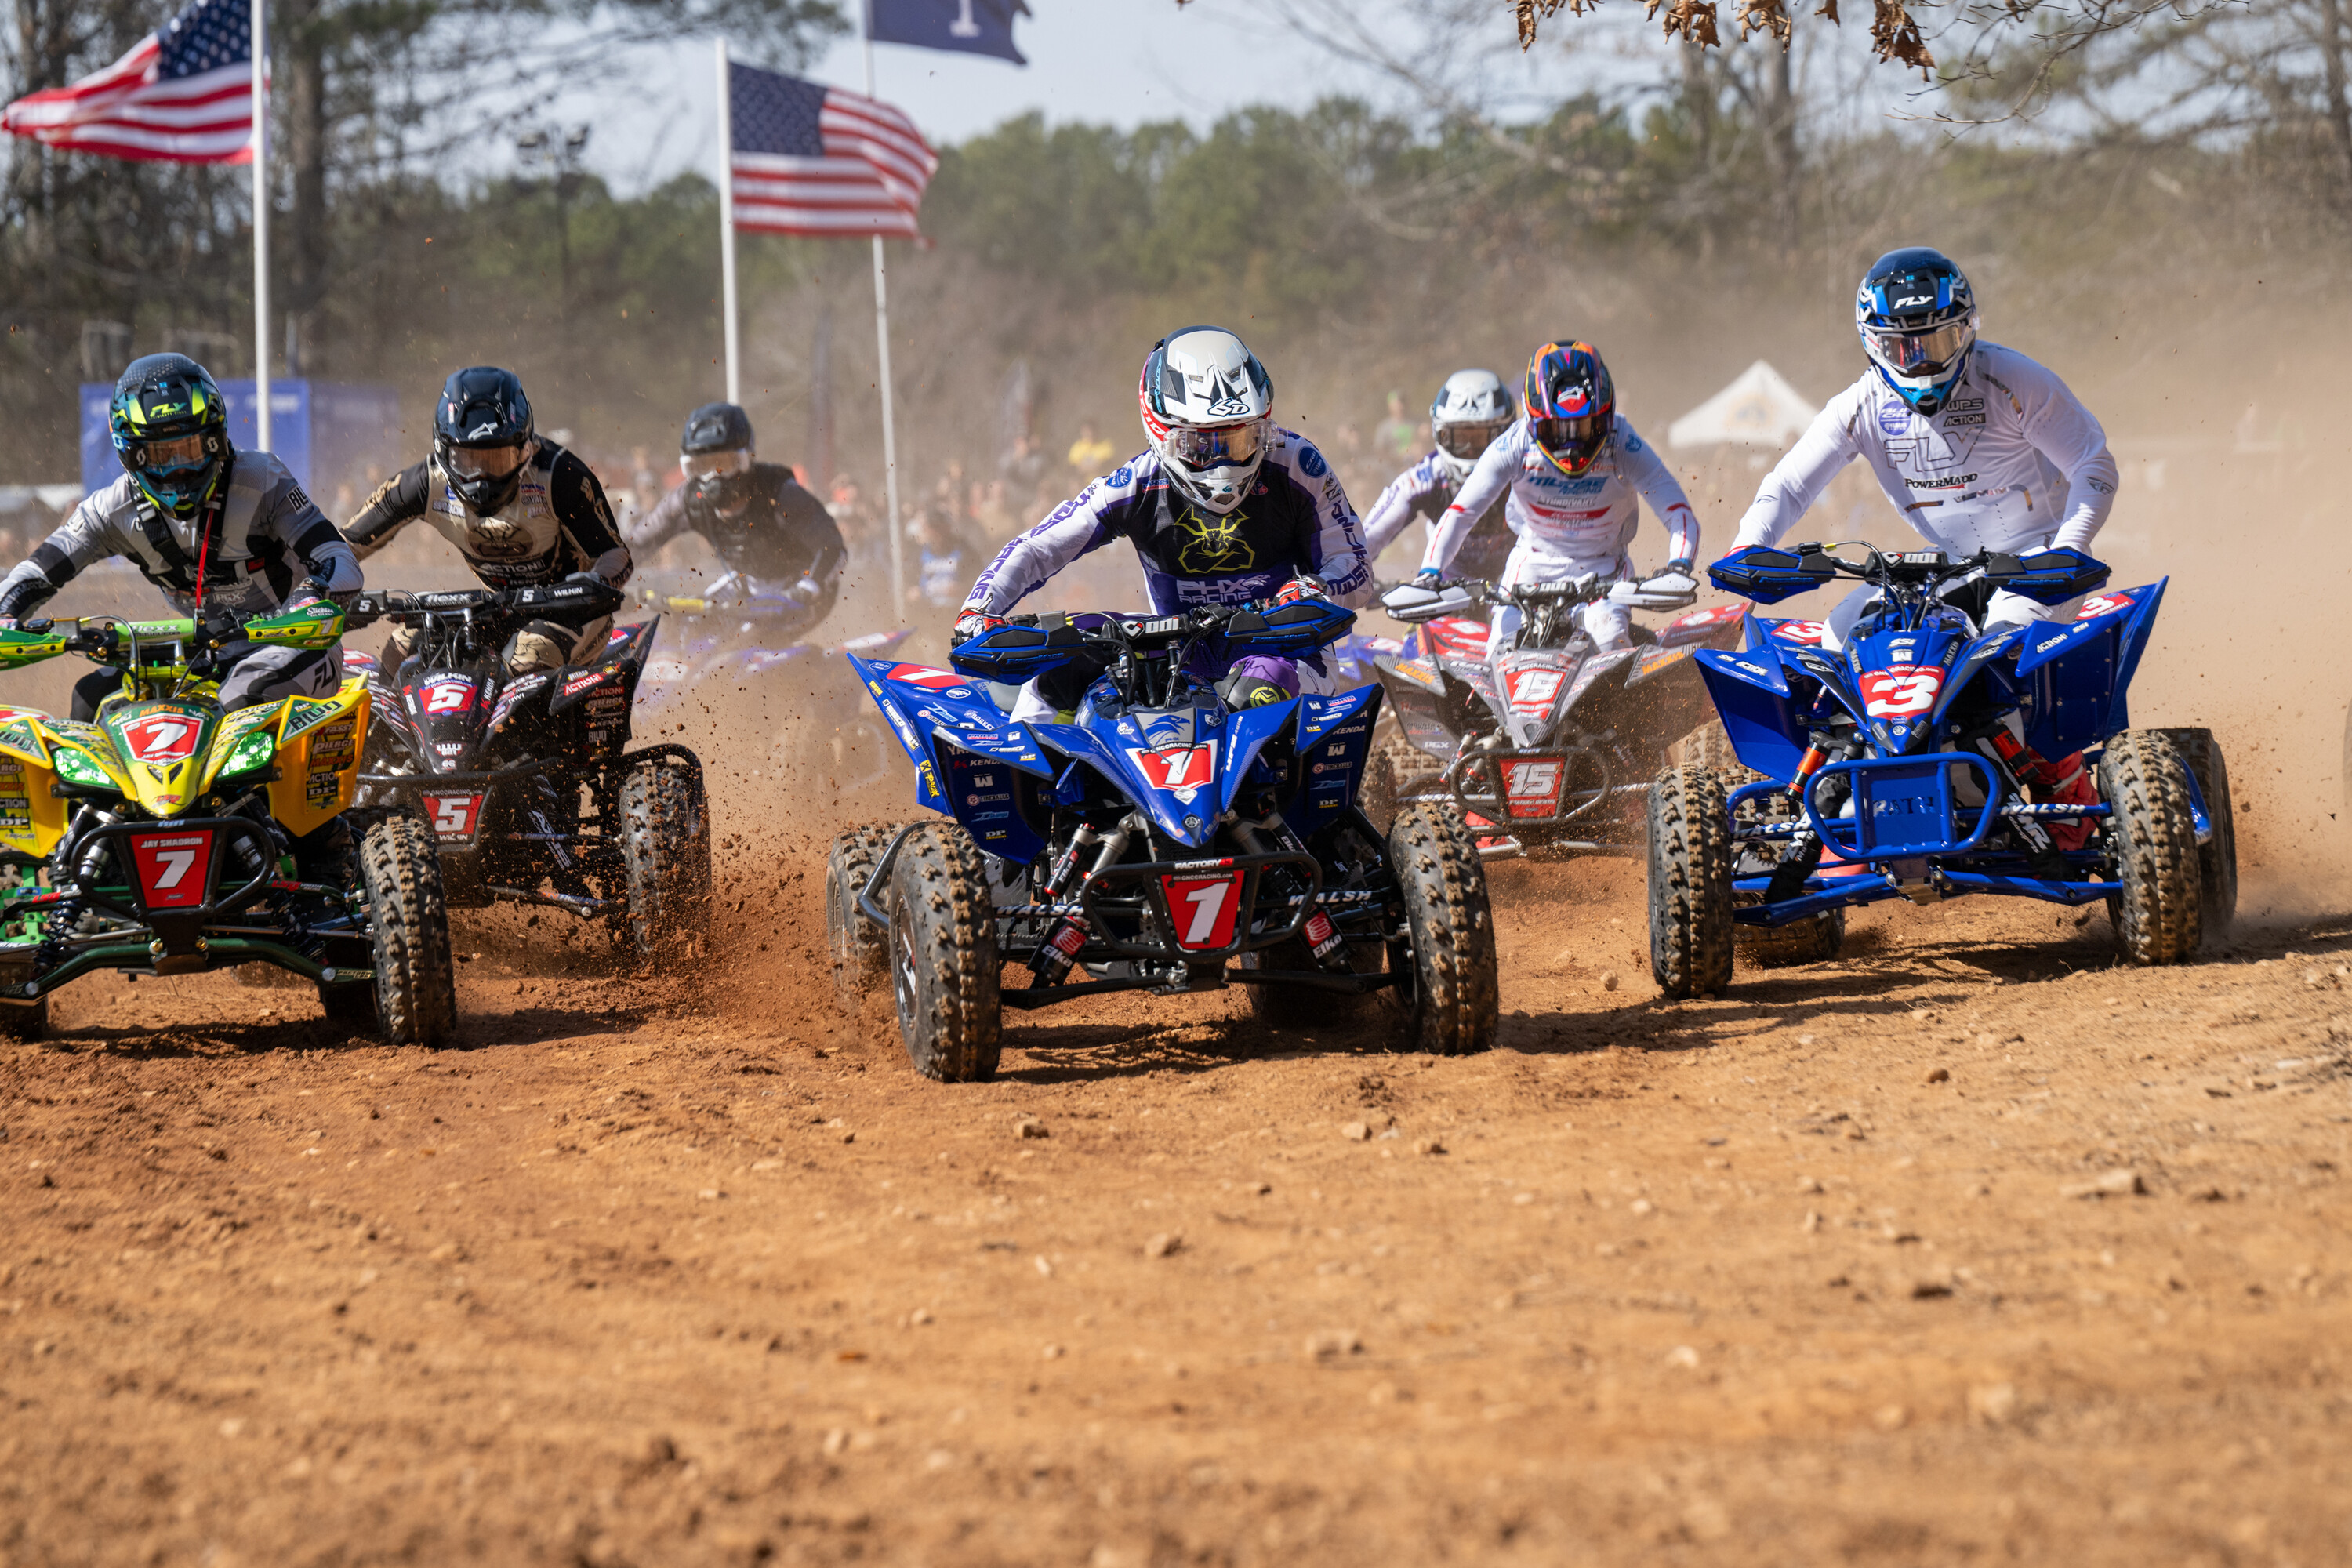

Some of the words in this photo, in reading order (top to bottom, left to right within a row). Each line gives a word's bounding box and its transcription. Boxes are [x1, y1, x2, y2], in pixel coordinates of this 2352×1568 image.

[1893, 296, 1933, 309] FLY
[150, 402, 187, 417] FLY
[1207, 397, 1250, 417] 6D
[1946, 397, 1984, 412] WPS
[1944, 414, 1983, 426] ACTION
[1884, 426, 1986, 472] FLY
[554, 587, 583, 597] WILKIN
[1177, 579, 1245, 594] PHX
[425, 593, 472, 603] flexx
[522, 590, 534, 602] 5
[1179, 591, 1252, 604] RACING
[358, 599, 372, 612] 5
[2078, 597, 2116, 618] 3
[320, 618, 334, 636] 7
[1943, 641, 1959, 666] MAXXIS
[1642, 652, 1686, 675] MAXXIS
[423, 672, 473, 686] WILKIN
[1395, 662, 1436, 684] MAXXIS
[483, 677, 495, 700] KENDA
[564, 674, 601, 695] ACTION
[1512, 672, 1564, 703] 15
[427, 684, 469, 712] 5
[592, 688, 624, 698] CTION
[1867, 674, 1939, 717] 3
[139, 704, 185, 717] MAXXIS
[142, 721, 189, 753] 7
[1333, 724, 1366, 735] KENDA
[310, 754, 354, 768] MAXXIS
[970, 758, 1000, 767] KEND
[1160, 750, 1194, 784] 1
[1508, 761, 1561, 797] 15
[308, 786, 336, 795] DP
[0, 798, 27, 809] CTION
[1872, 795, 1935, 818] RATH
[2000, 804, 2086, 815] WALSH
[434, 797, 471, 832] 5
[141, 840, 159, 848] JAY
[159, 837, 204, 848] SHADRON
[1280, 835, 1296, 852] Elk
[153, 849, 196, 890] 7
[996, 904, 1084, 916] WALSH
[1185, 881, 1230, 943] 1
[1313, 933, 1342, 960] Elka
[1041, 944, 1074, 968] Elka
